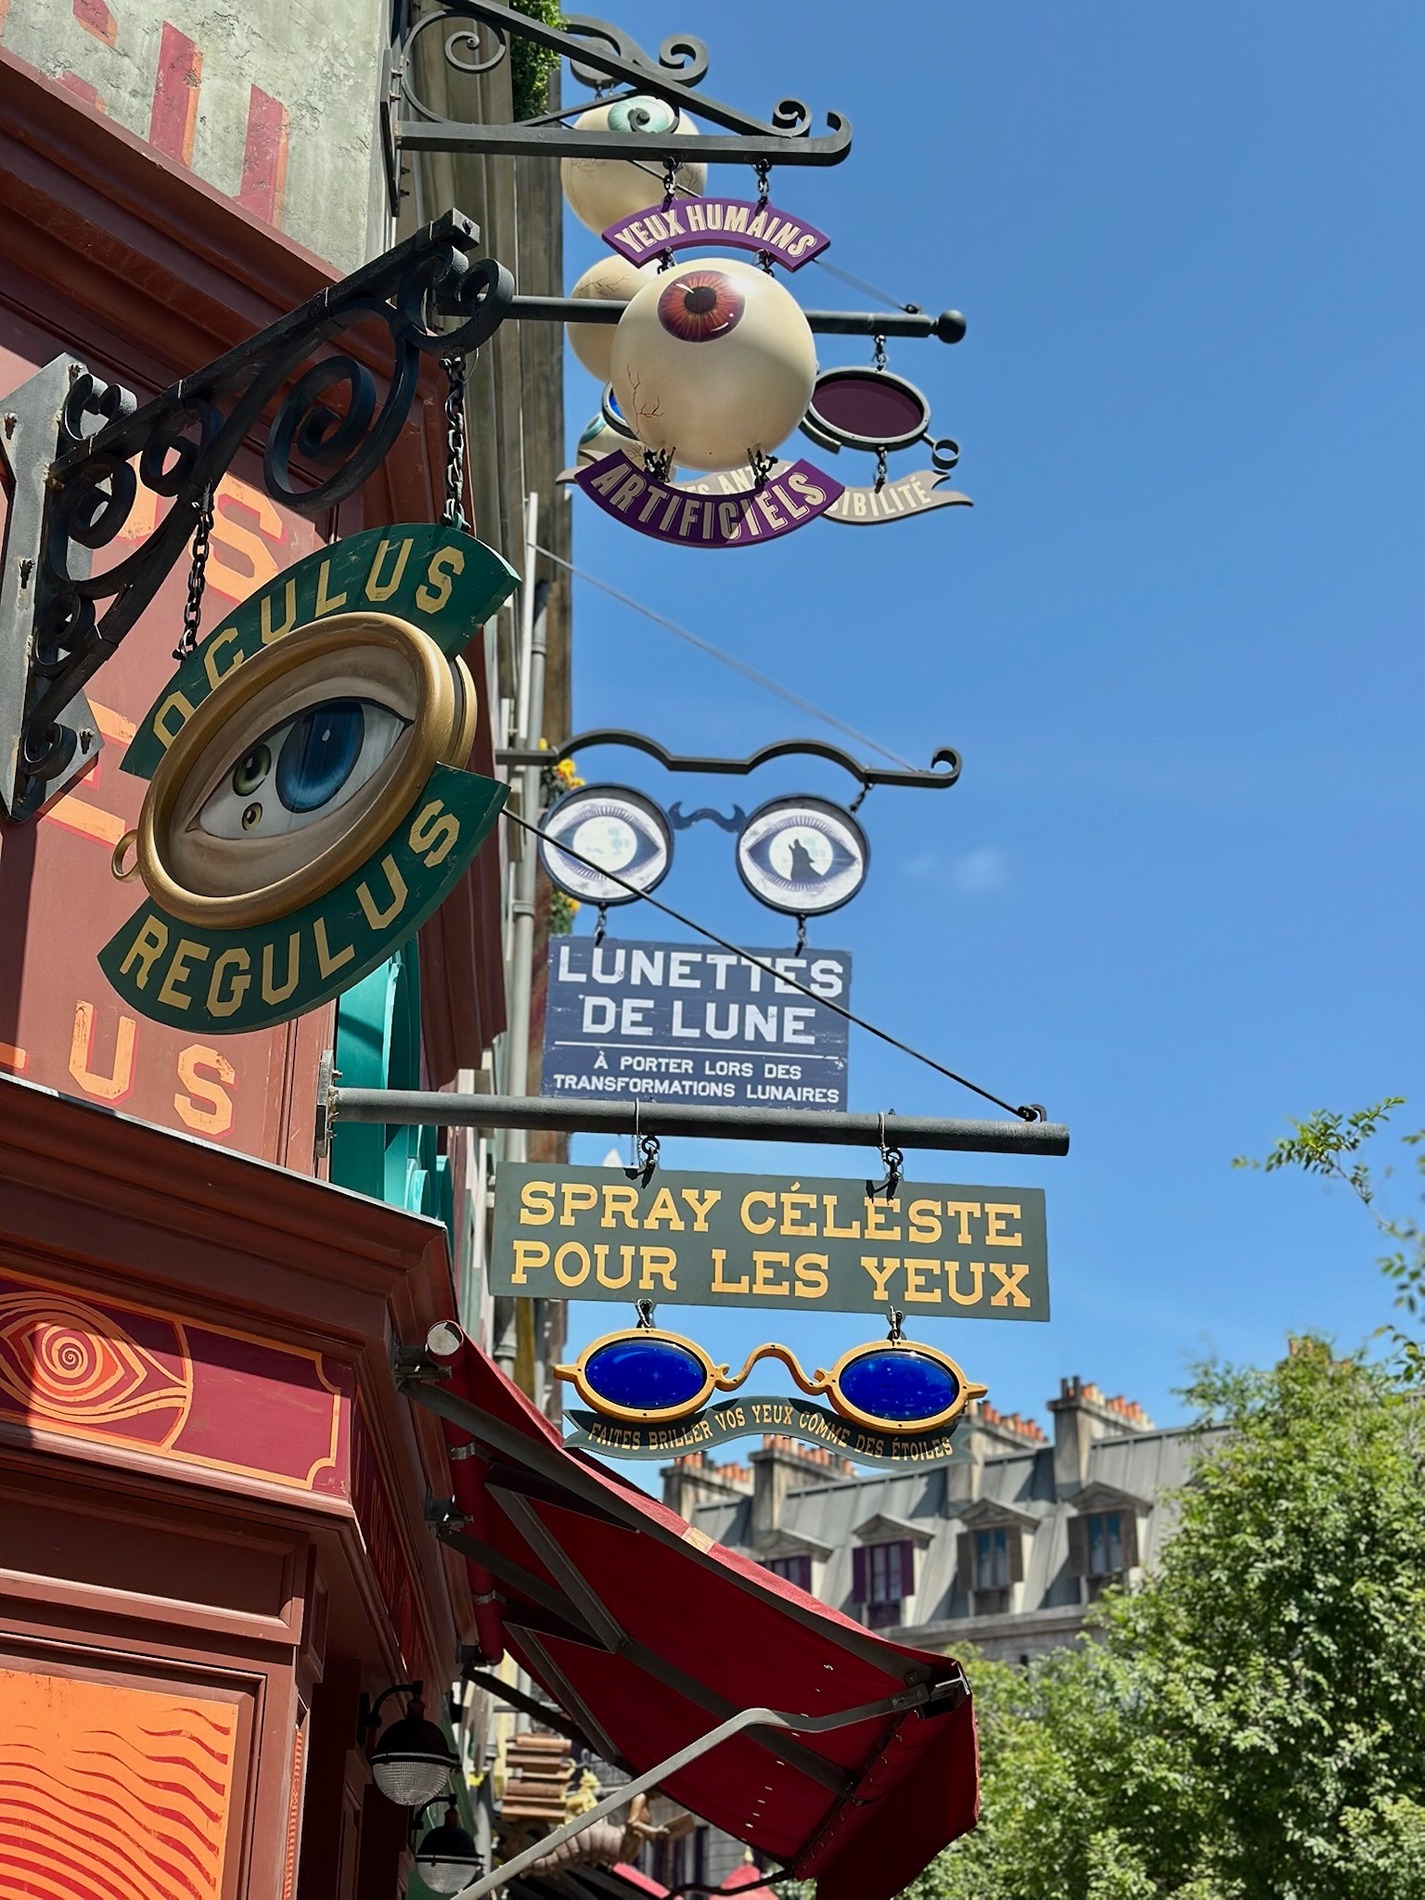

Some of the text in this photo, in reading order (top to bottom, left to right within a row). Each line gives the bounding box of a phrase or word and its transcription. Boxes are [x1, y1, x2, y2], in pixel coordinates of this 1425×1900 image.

[614, 203, 818, 257] YEUX HUMAINS
[591, 463, 827, 541] ARTIFICIELS
[153, 538, 465, 749] OCULUS
[119, 799, 461, 1017] REGULUS
[558, 945, 843, 998] LUNETTES
[582, 996, 816, 1045] DE LUNE
[0, 1000, 237, 1138] US
[553, 1074, 840, 1104] TRANSFORMATIONS LUNAIRES
[593, 1051, 802, 1080] À PORTER LORS DES
[519, 1180, 1023, 1248] SPRAY CÉLESTE
[511, 1240, 1032, 1308] POUR LES YEUX
[587, 1404, 953, 1462] FAITES BRILLER VOS YEUX COMME DES ÉTOILES
